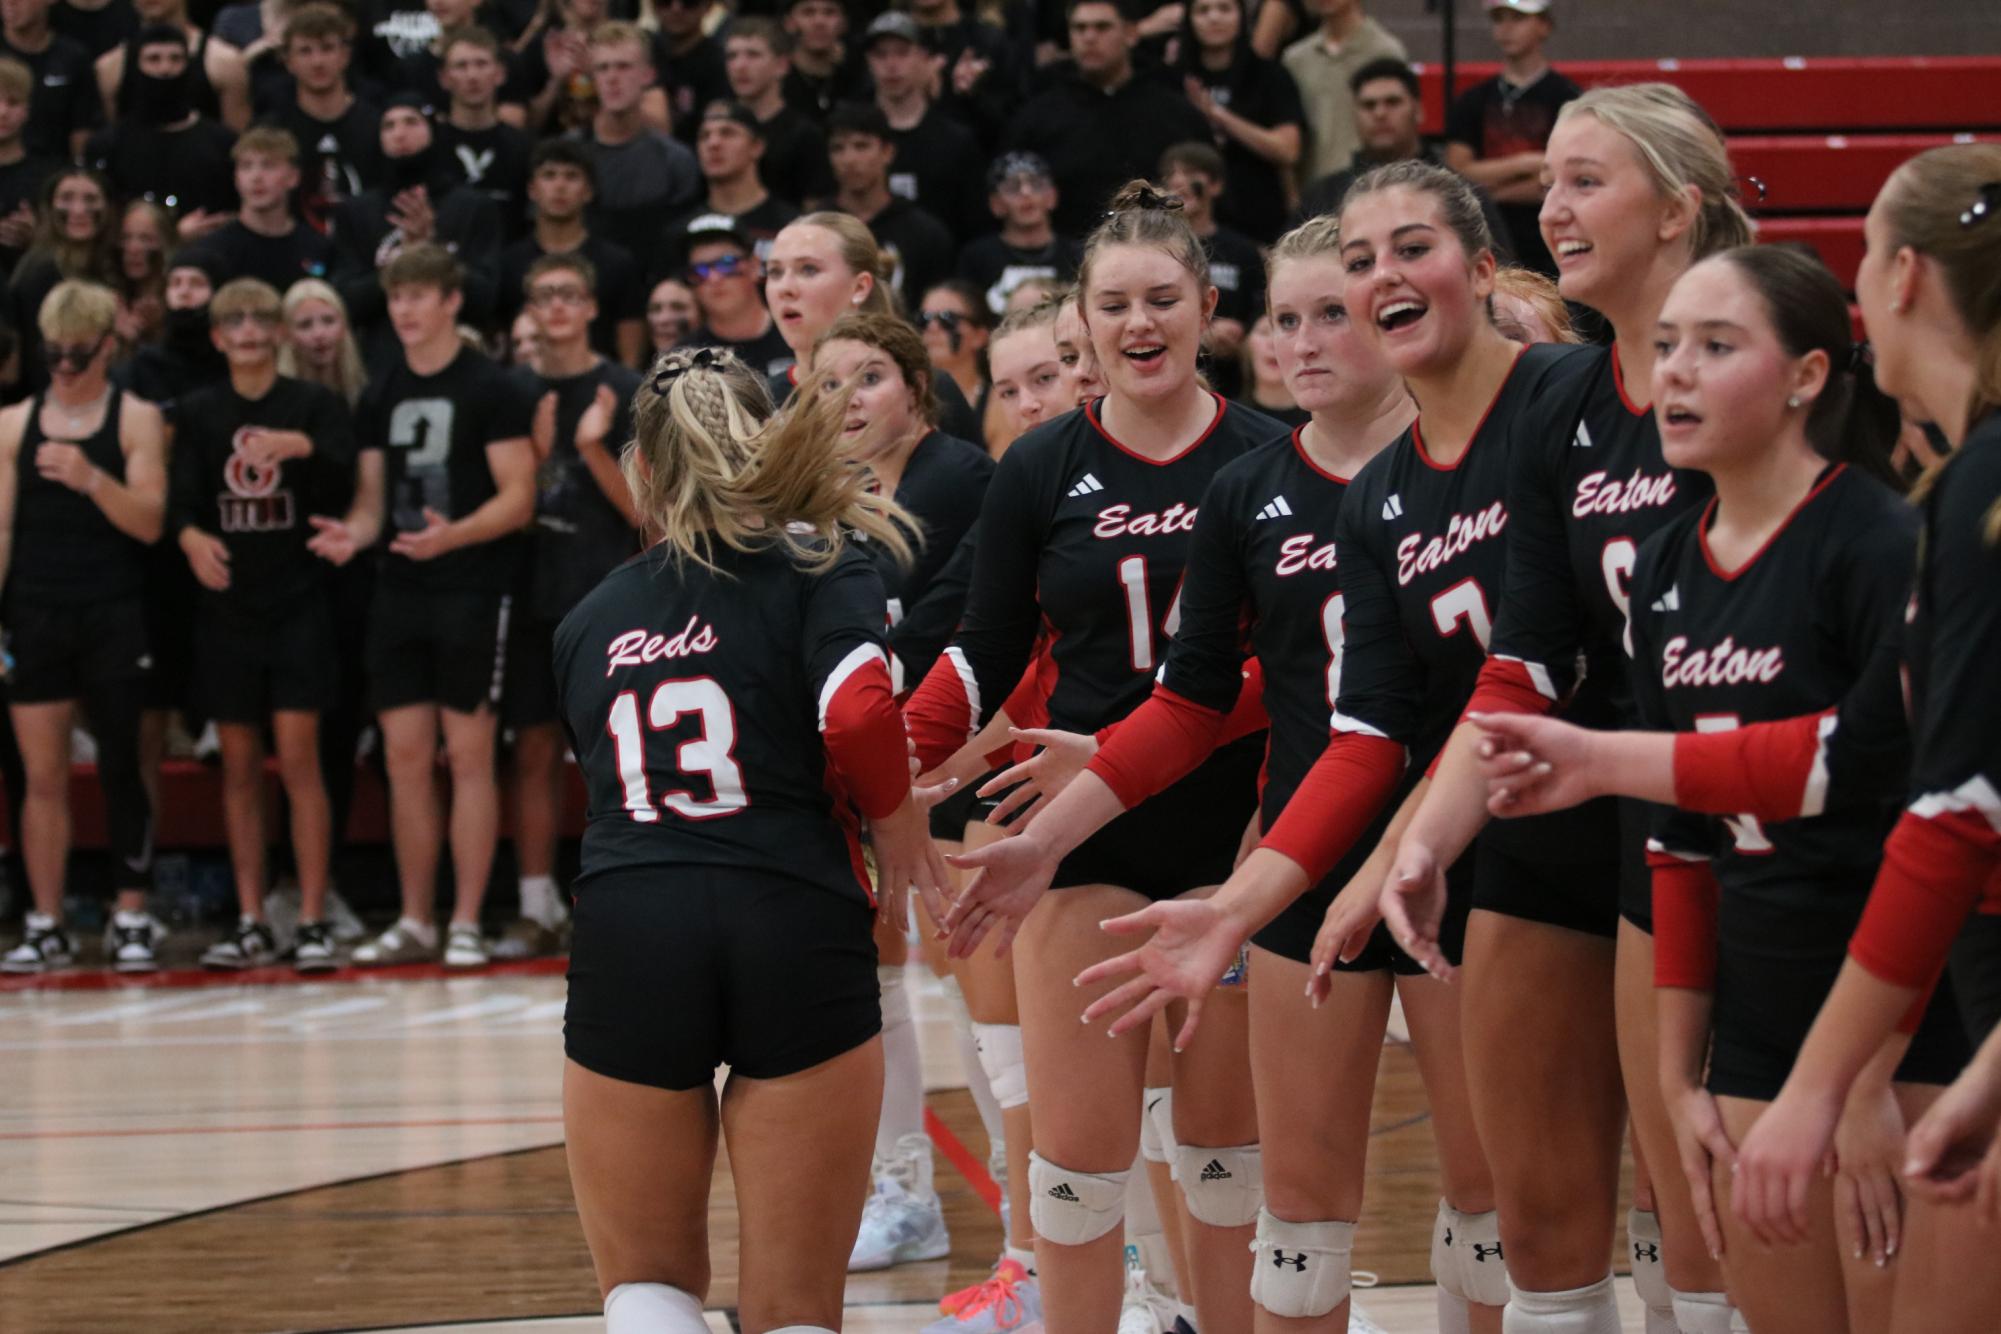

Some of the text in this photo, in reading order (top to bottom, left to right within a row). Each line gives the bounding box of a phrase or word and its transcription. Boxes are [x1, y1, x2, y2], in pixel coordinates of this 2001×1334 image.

[1571, 467, 1677, 519] Eaton
[1396, 500, 1509, 588] Eaton
[606, 613, 719, 677] Reds
[1661, 634, 1785, 689] Eaton
[606, 674, 751, 824] 13
